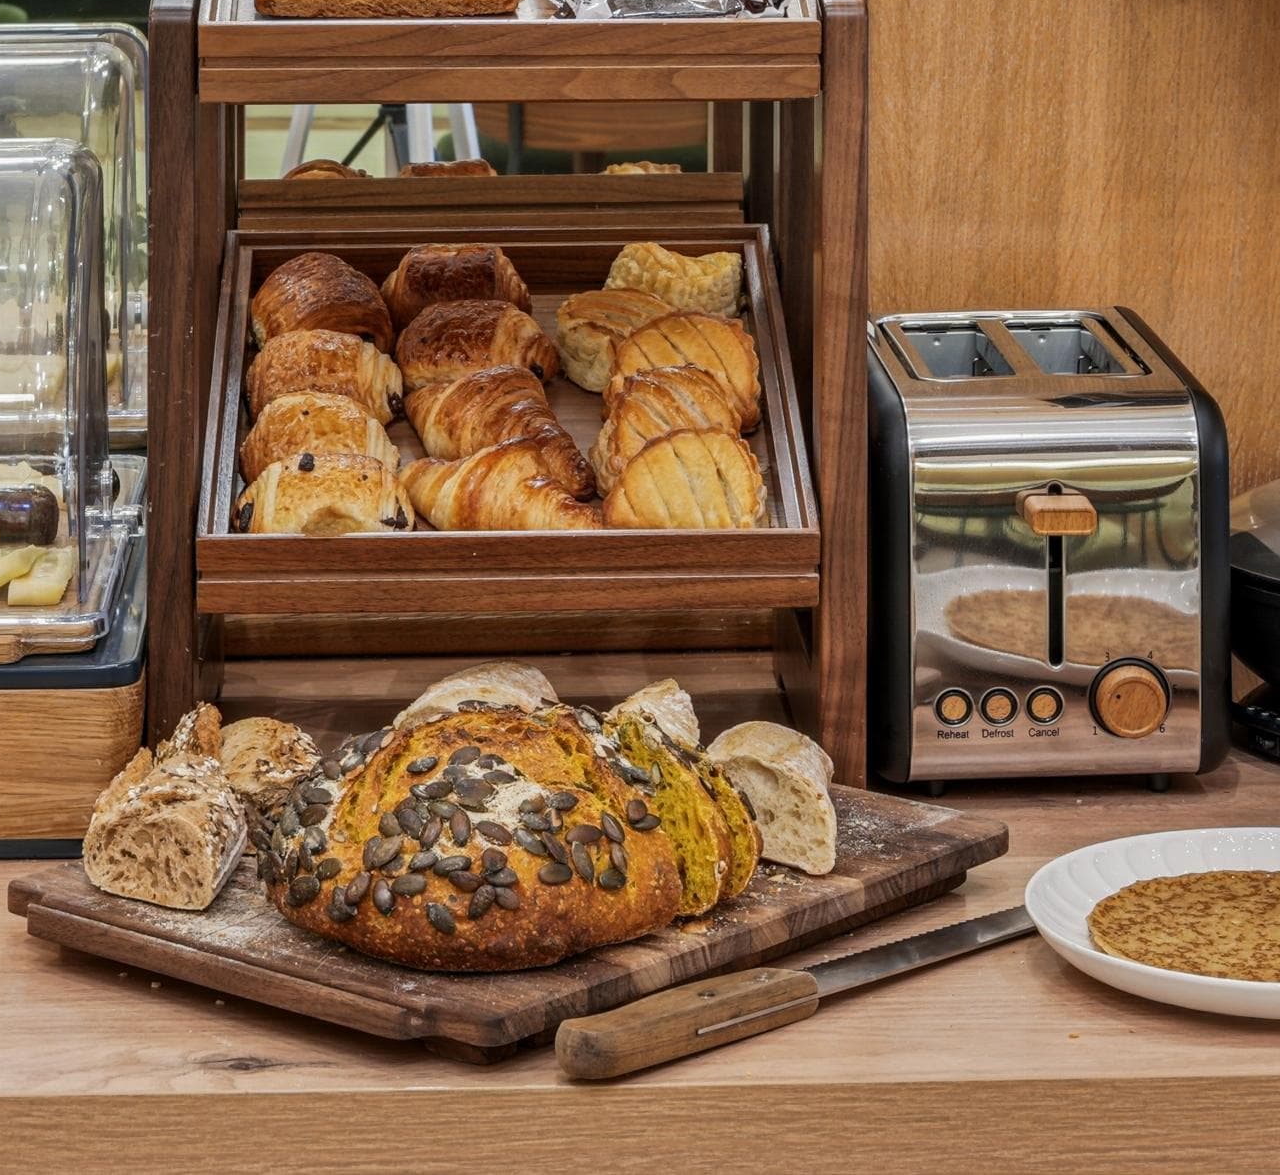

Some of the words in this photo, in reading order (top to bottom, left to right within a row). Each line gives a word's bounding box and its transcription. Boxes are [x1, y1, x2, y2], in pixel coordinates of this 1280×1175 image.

[1105, 652, 1110, 662] 3
[1147, 650, 1153, 659] 4
[982, 728, 1014, 738] Defrost
[1028, 727, 1060, 737] Cancel
[1093, 727, 1098, 736] 1
[1159, 724, 1165, 733] 6
[937, 729, 970, 739] Reheat
